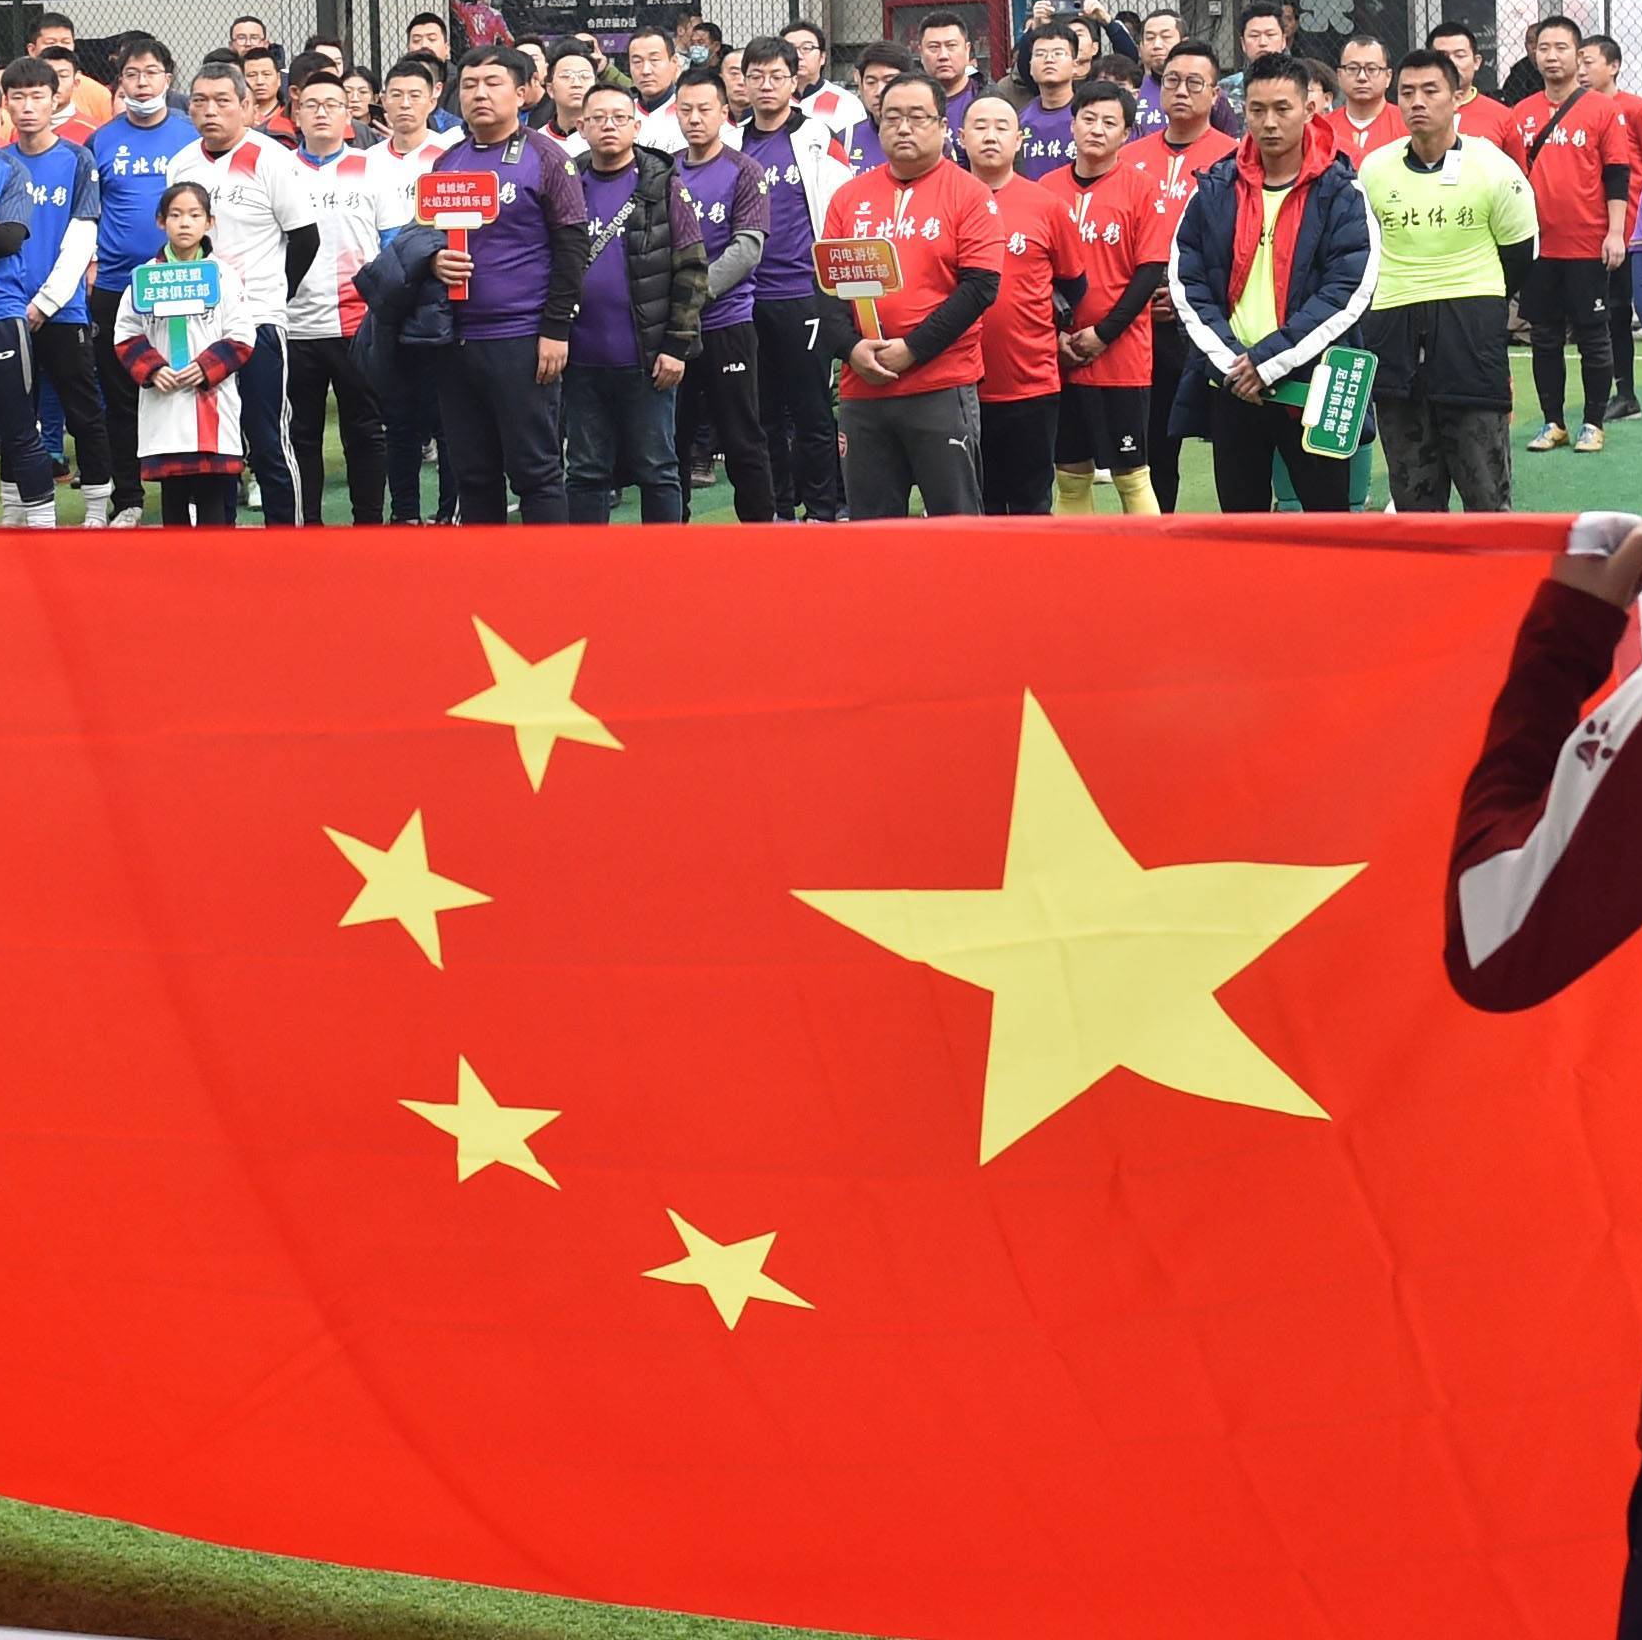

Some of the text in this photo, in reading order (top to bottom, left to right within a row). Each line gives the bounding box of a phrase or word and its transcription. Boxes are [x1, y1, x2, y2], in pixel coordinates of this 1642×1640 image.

[1523, 128, 1586, 147] 河体彩
[26, 181, 68, 207] 体彩
[308, 186, 360, 209] 体彩
[828, 264, 890, 281] 足球俱乐部
[143, 283, 210, 302] 足球俱乐部
[1322, 366, 1348, 433] 足球俱乐部
